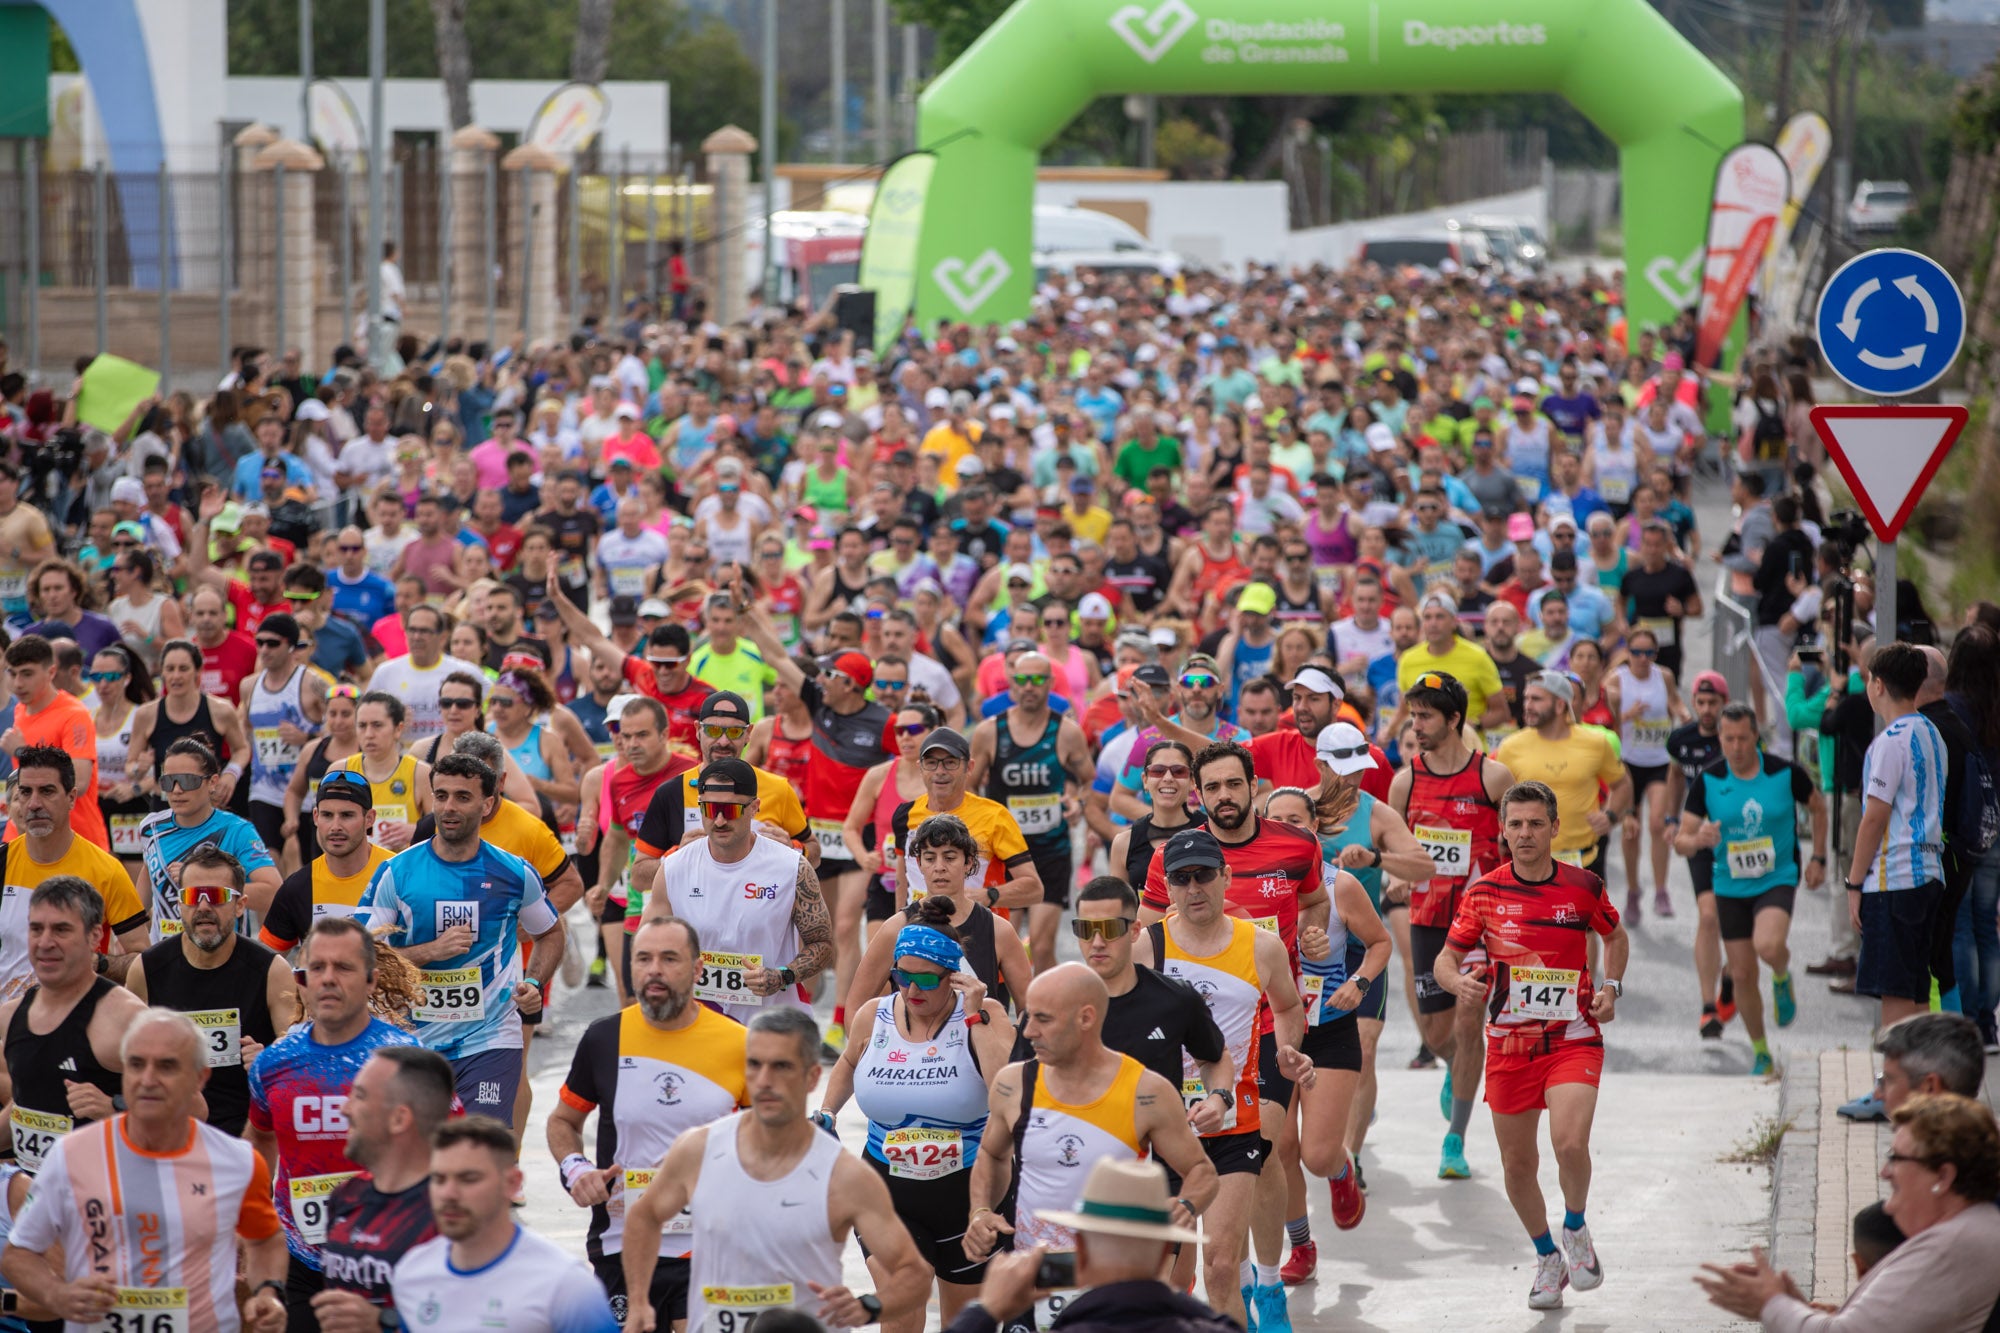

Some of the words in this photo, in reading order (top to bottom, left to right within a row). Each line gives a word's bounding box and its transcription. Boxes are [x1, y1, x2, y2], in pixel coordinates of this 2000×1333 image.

[1205, 18, 1346, 42] Diputación
[1404, 20, 1547, 51] Deportes
[1203, 45, 1236, 63] de
[1239, 43, 1348, 63] Granada
[1002, 762, 1050, 787] Giit
[1019, 809, 1051, 824] 351
[113, 828, 142, 843] 21
[1735, 851, 1769, 869] 189
[442, 905, 473, 920] RUN
[697, 967, 748, 990] 318
[1520, 969, 1531, 979] 38
[424, 987, 480, 1009] 359
[1520, 985, 1567, 1006] 147
[867, 1065, 959, 1080] MARACENA
[479, 1081, 500, 1091] RUN
[479, 1090, 500, 1101] RUN
[15, 1128, 56, 1158] 242
[896, 1131, 907, 1142] 38
[885, 1143, 960, 1166] 2124
[635, 1173, 648, 1183] 38
[303, 1200, 328, 1226] 9
[103, 1312, 174, 1333] 316
